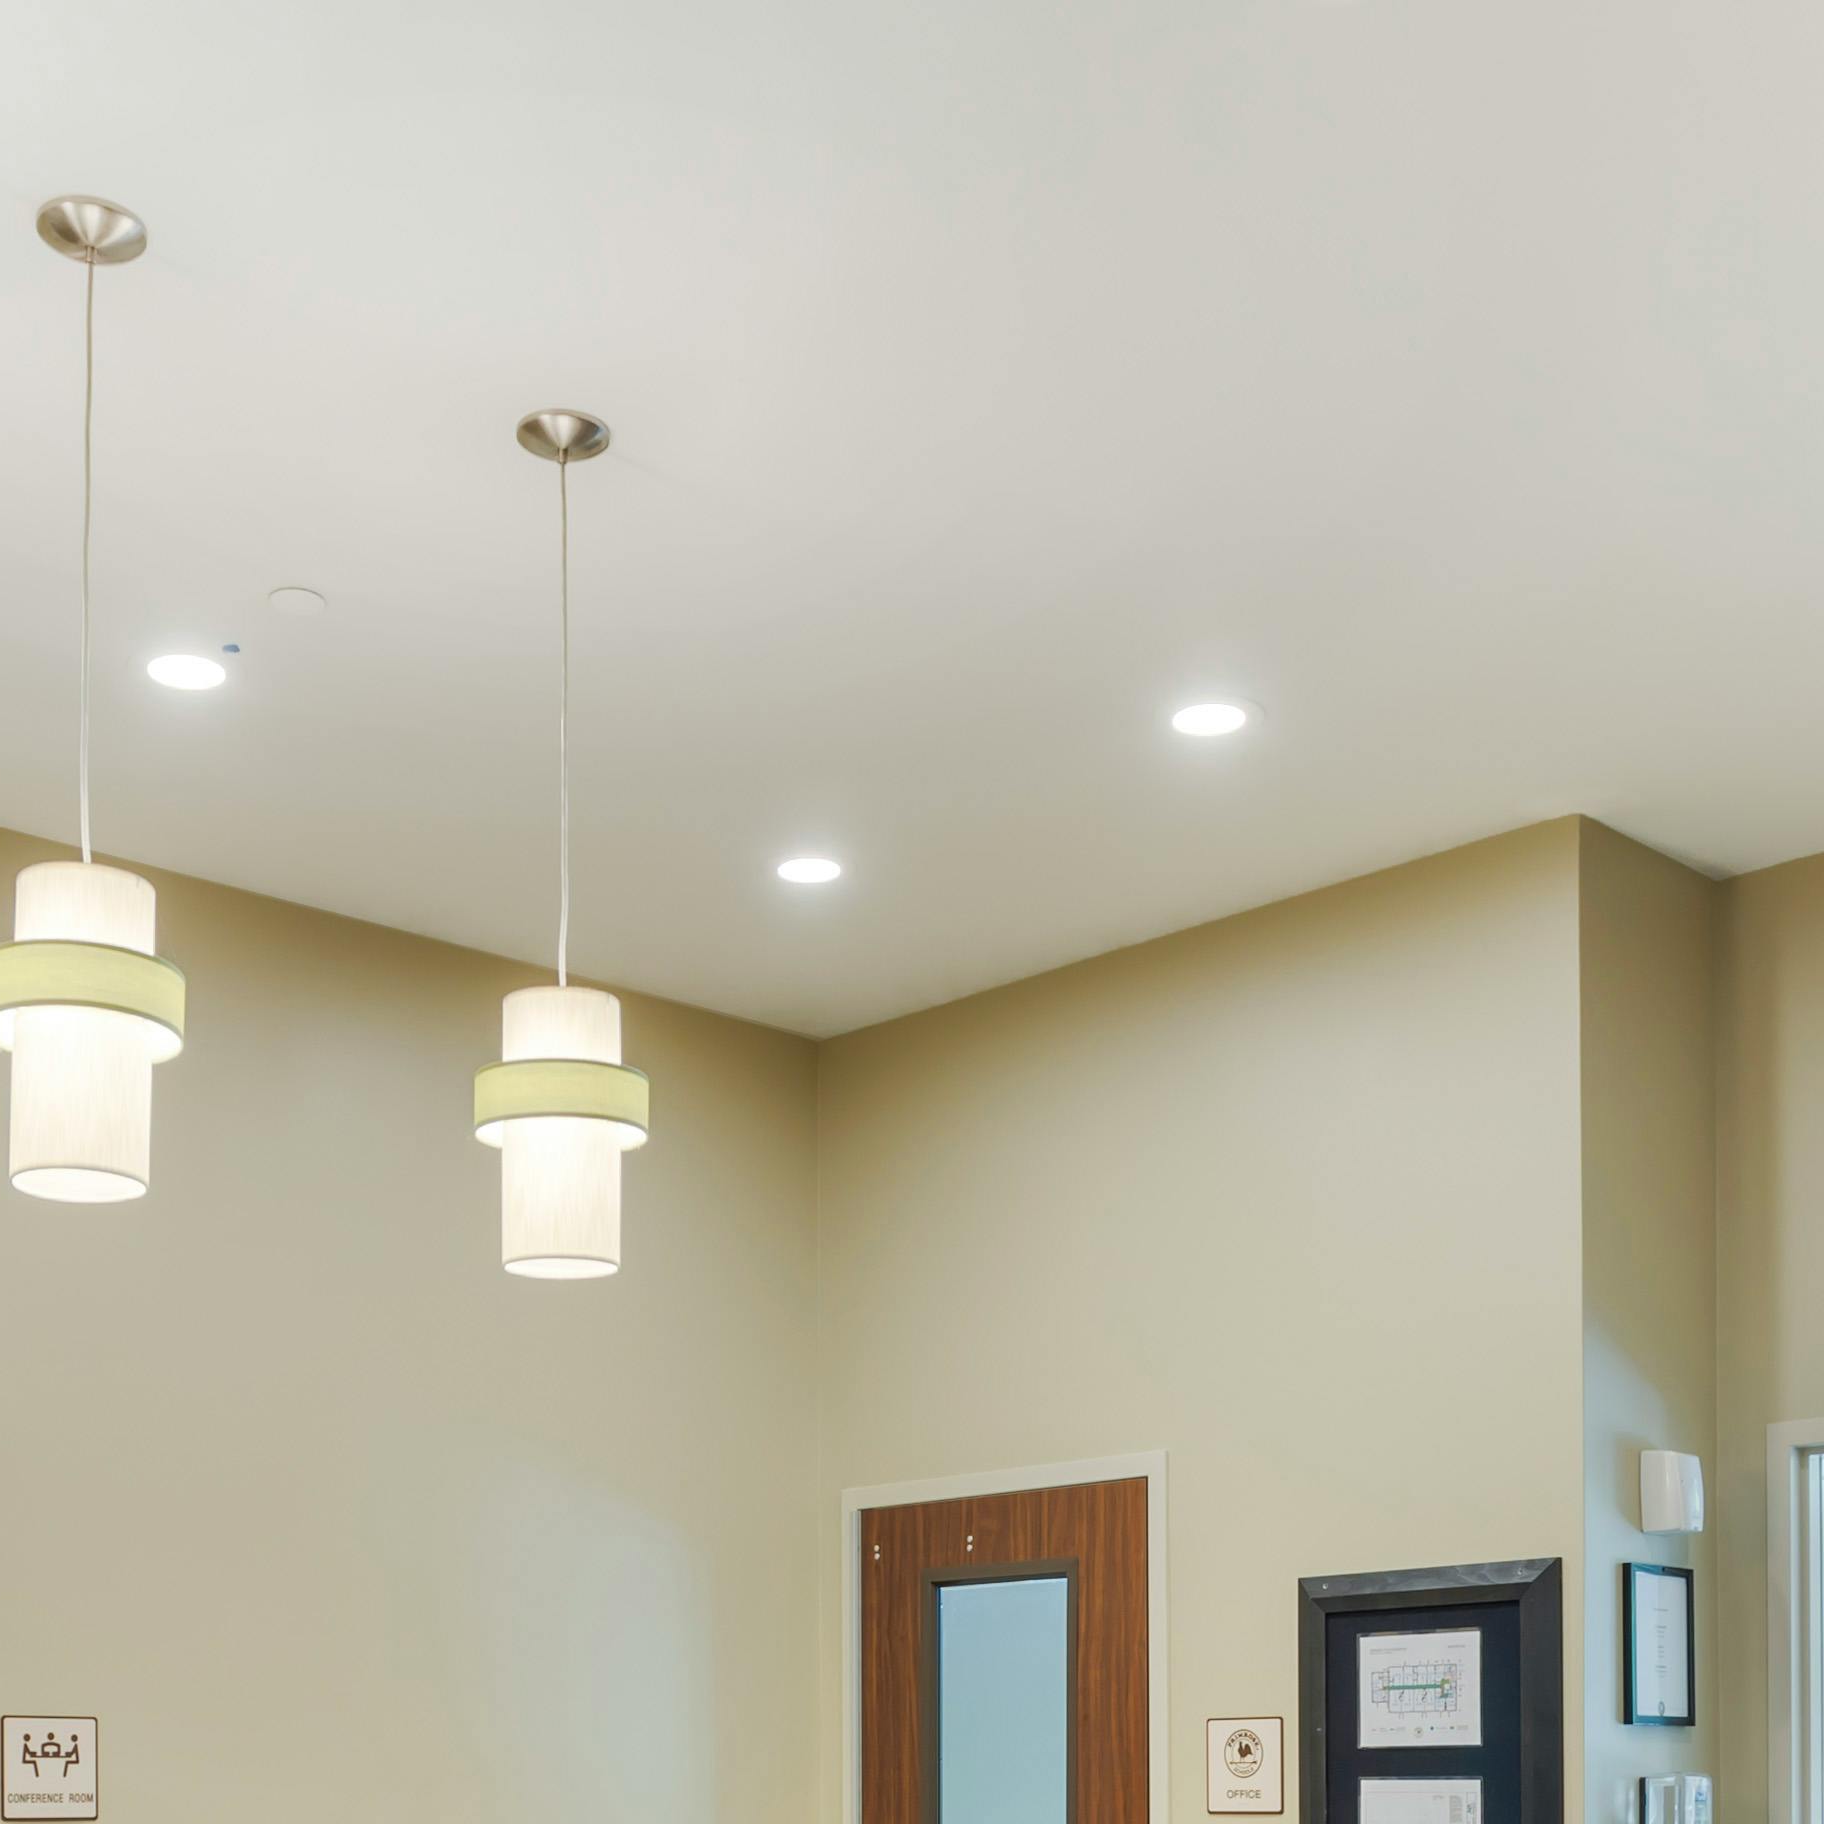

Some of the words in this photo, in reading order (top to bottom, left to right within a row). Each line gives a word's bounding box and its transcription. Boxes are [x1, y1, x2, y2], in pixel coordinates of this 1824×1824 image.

[7, 1793, 64, 1804] CONFERENCE
[69, 1793, 94, 1803] ROOM
[1226, 1789, 1262, 1799] OFFICE
